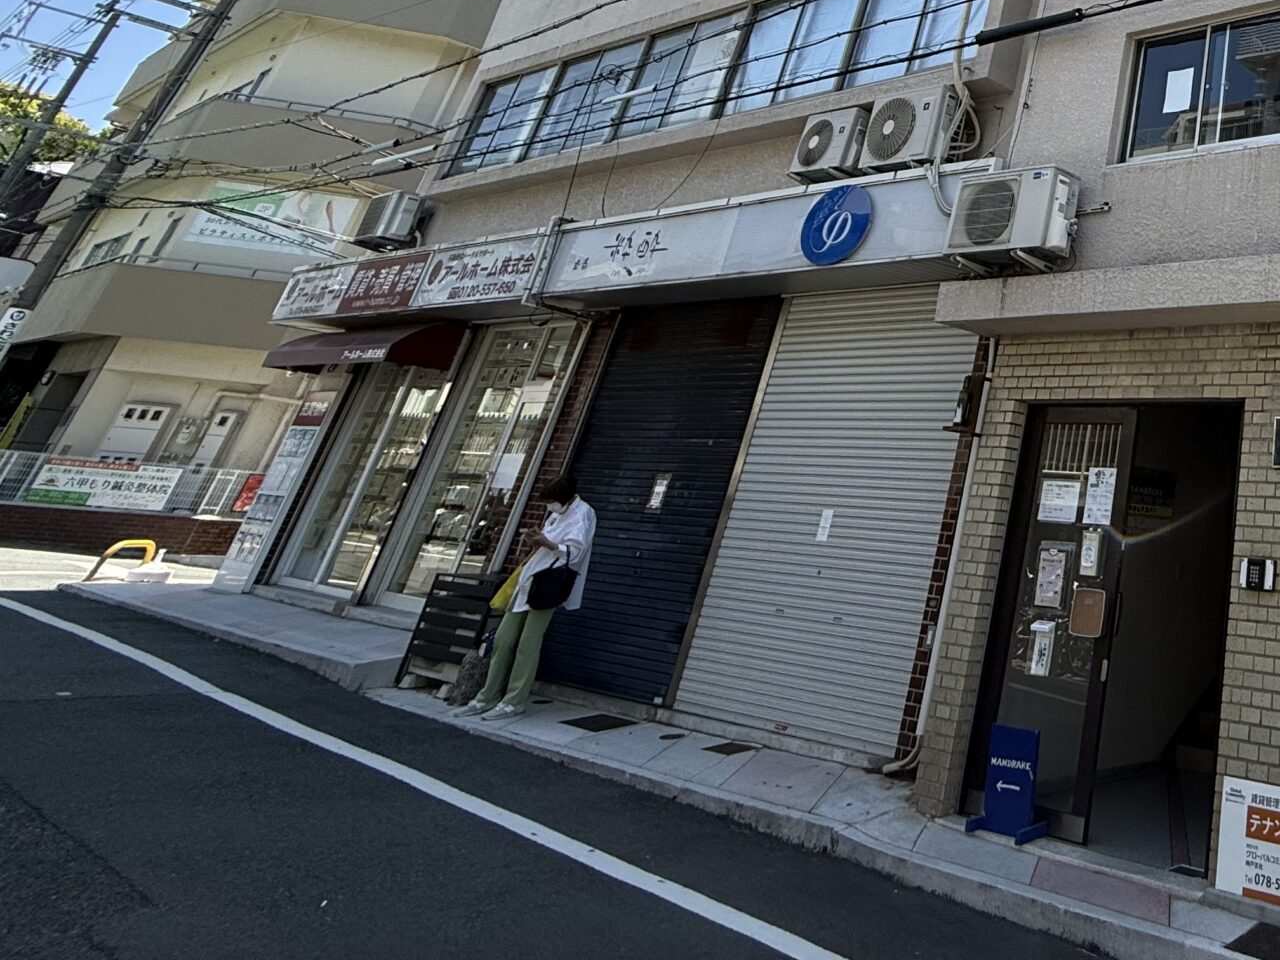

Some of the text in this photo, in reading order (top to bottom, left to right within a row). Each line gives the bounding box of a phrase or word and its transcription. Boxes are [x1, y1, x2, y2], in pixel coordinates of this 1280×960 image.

[438, 252, 547, 283] アールホーム株式会
[63, 476, 172, 496] 六甲もり鍼灸整体院
[990, 756, 1032, 771] MANDRAKE
